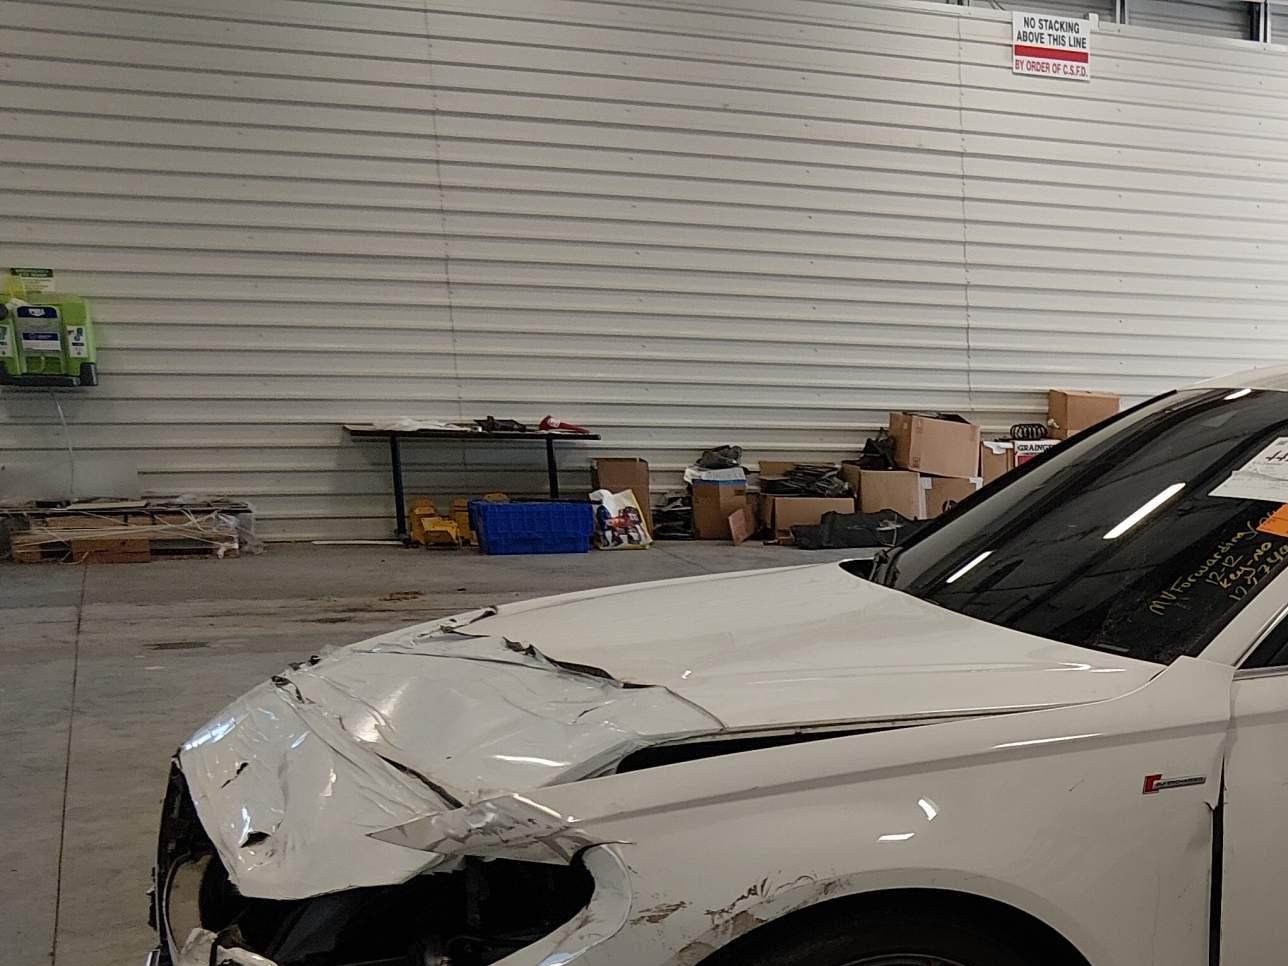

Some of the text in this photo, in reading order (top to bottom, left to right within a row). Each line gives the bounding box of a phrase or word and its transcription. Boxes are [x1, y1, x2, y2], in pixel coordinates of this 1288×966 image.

[1023, 16, 1080, 34] NO STACKING
[1016, 30, 1087, 49] ABOVE THIS LINE
[1015, 59, 1024, 71] BY
[1026, 61, 1050, 73] ORDER
[1052, 62, 1061, 74] OF
